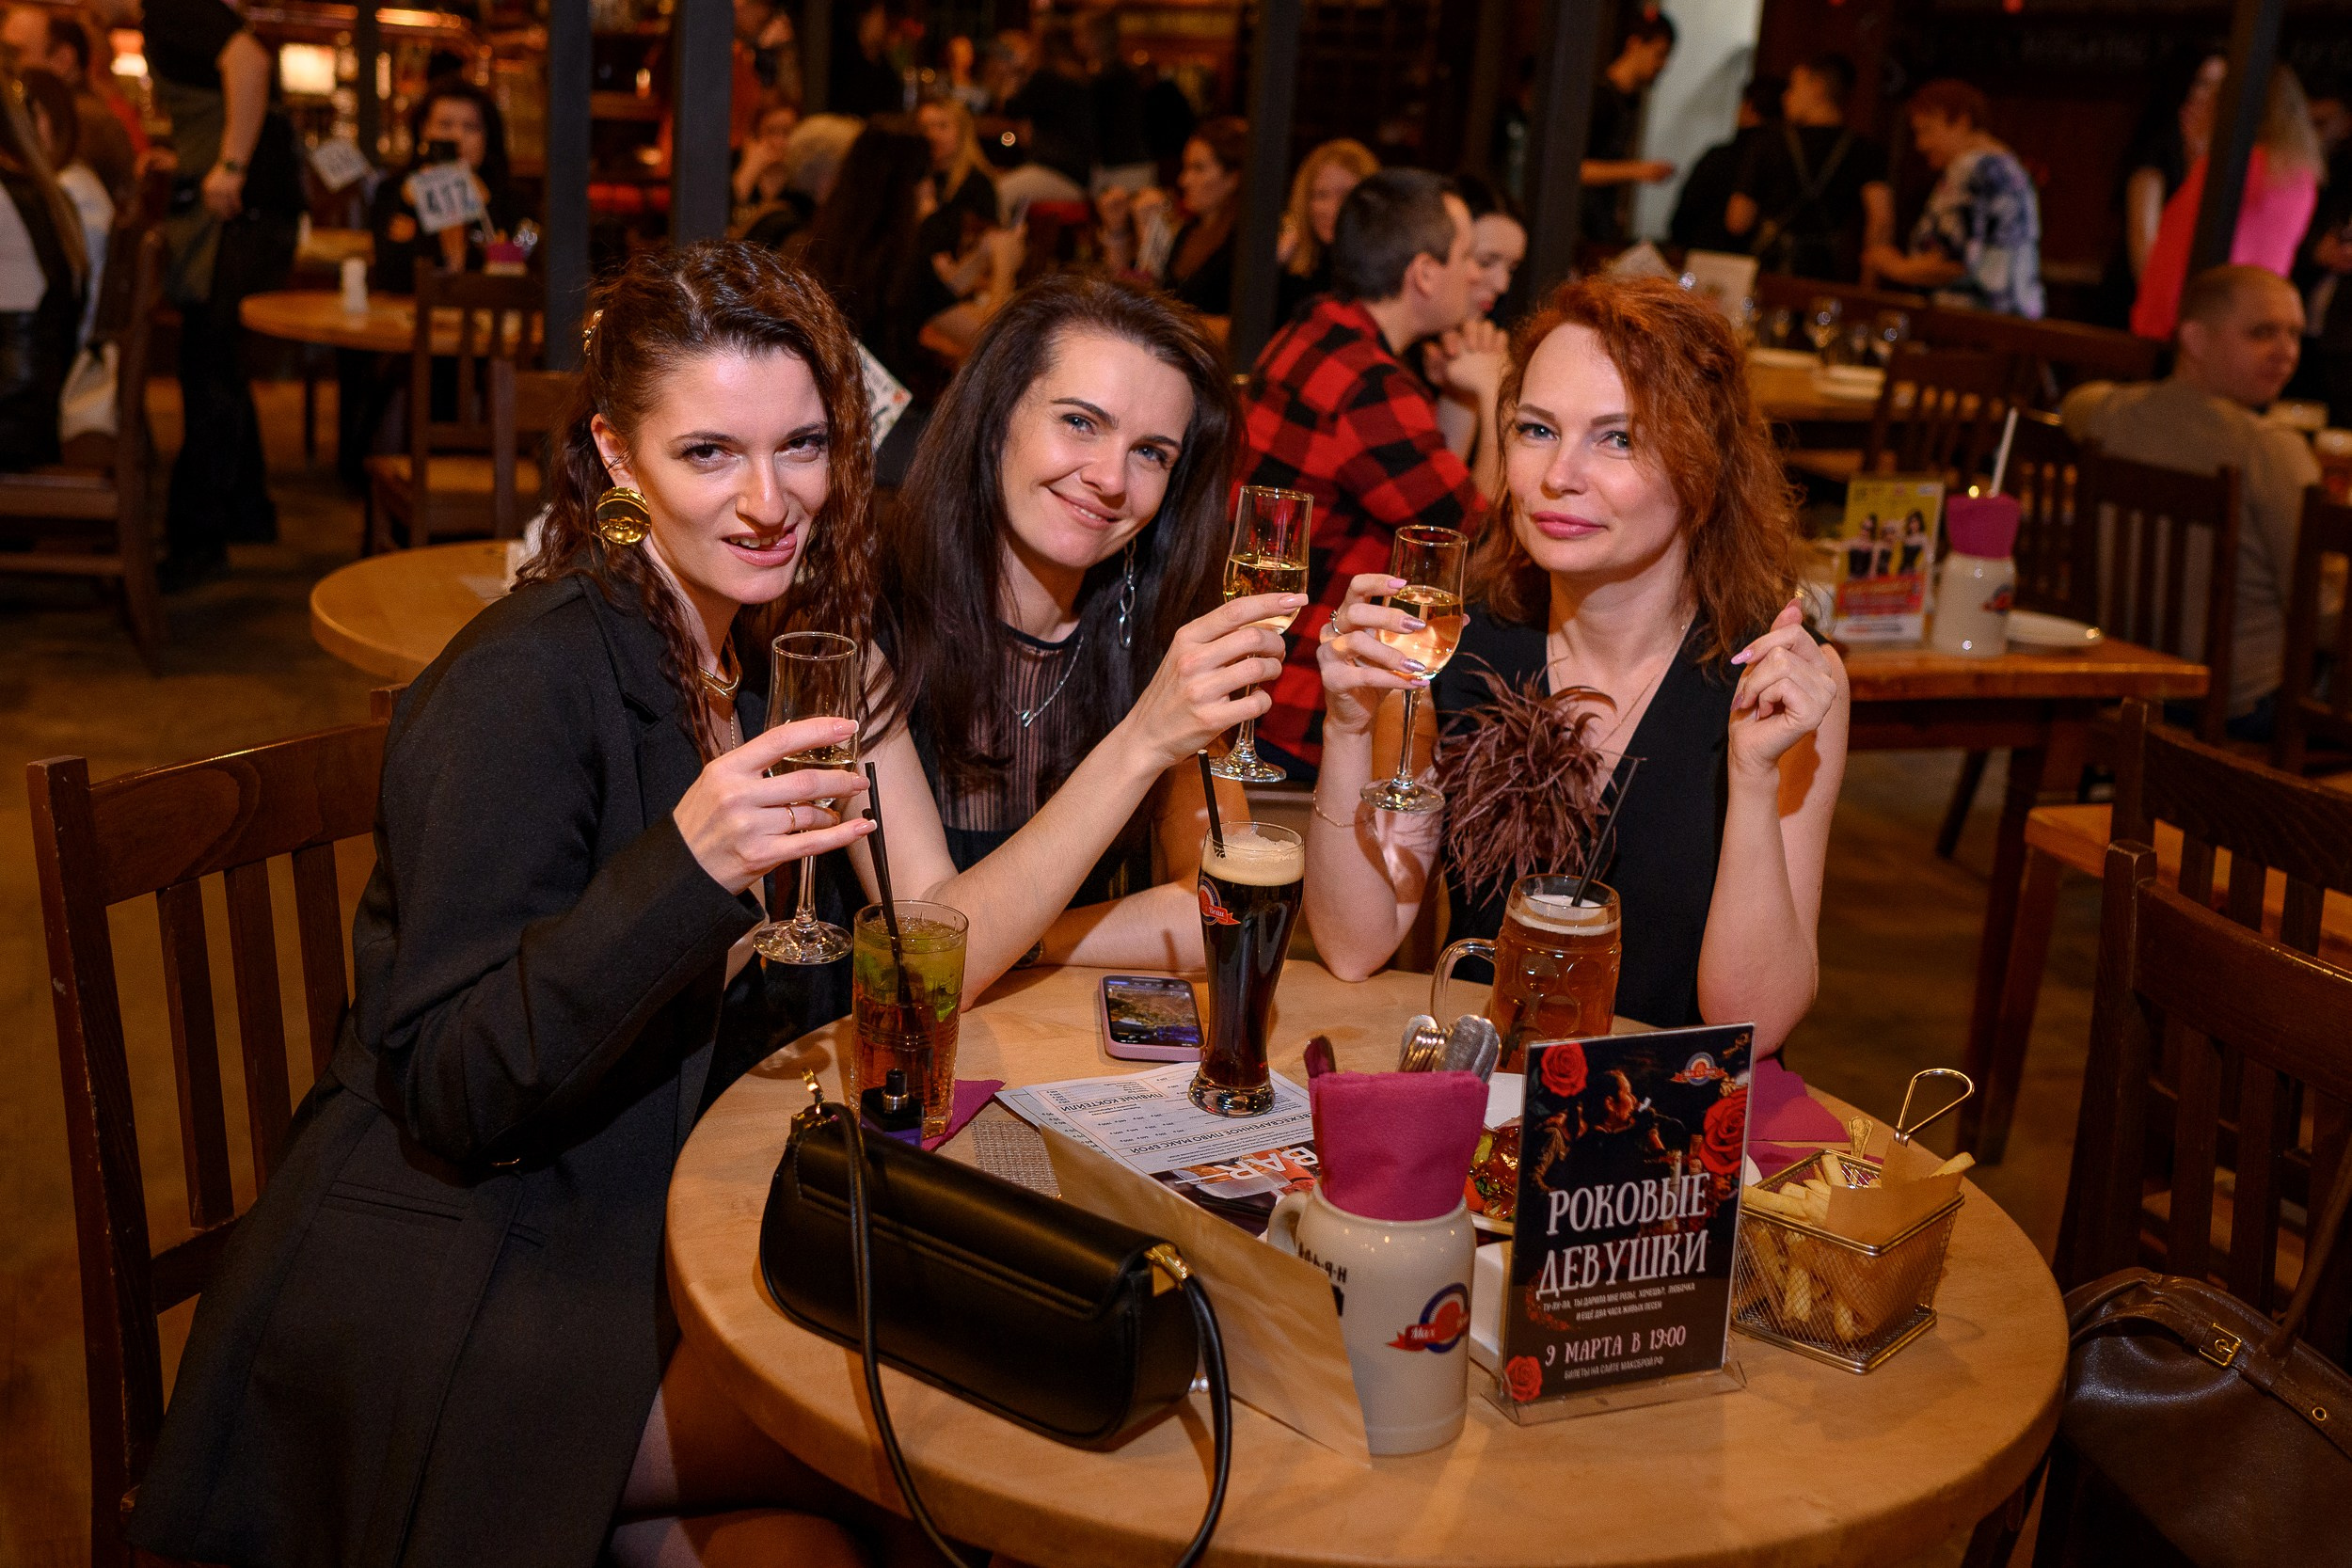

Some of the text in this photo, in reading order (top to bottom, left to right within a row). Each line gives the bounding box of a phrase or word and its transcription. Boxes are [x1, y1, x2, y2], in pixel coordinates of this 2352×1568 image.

[1061, 1098, 1119, 1112] КОКТЕЙЛИ
[1120, 1093, 1164, 1102] ПИВНЫЕ
[1224, 1112, 1313, 1134] ВЕЖЕСВАРЕННОЕ
[1160, 1137, 1193, 1148] МАКС
[1193, 1132, 1224, 1142] ПИВО
[1130, 1143, 1162, 1154] БРОЙ
[1215, 1146, 1319, 1180] BAR
[1546, 1172, 1710, 1236] РОКОВЫЕ
[1535, 1229, 1709, 1300] ДЕВУШКИ
[1544, 1324, 1687, 1368] 9 МАРТА В 19:00
